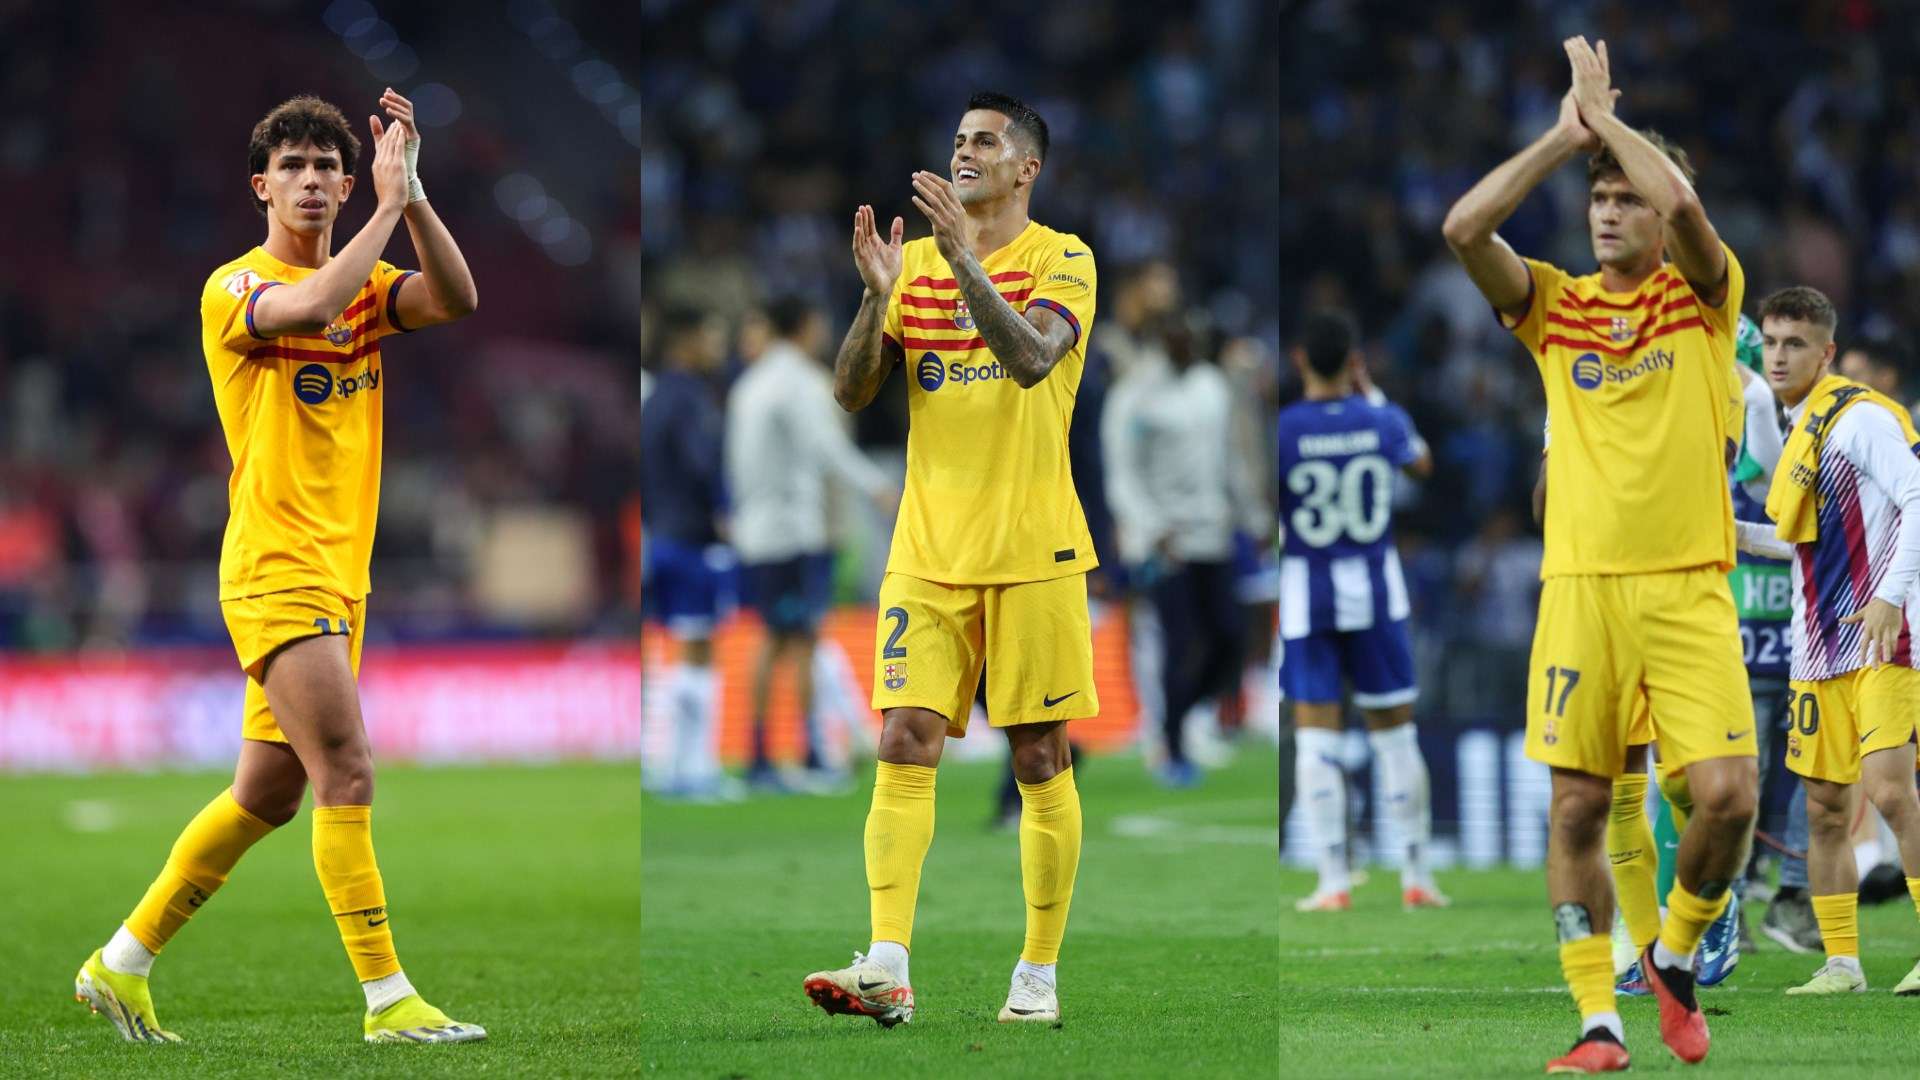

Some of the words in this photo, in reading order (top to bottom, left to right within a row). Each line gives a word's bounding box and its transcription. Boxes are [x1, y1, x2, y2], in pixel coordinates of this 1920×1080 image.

[1047, 273, 1089, 291] AMBILIGHT
[336, 367, 380, 398] Spotify
[1604, 349, 1675, 384] Spotify
[1287, 453, 1393, 548] 30
[883, 606, 909, 660] 2
[1545, 666, 1580, 717] 17
